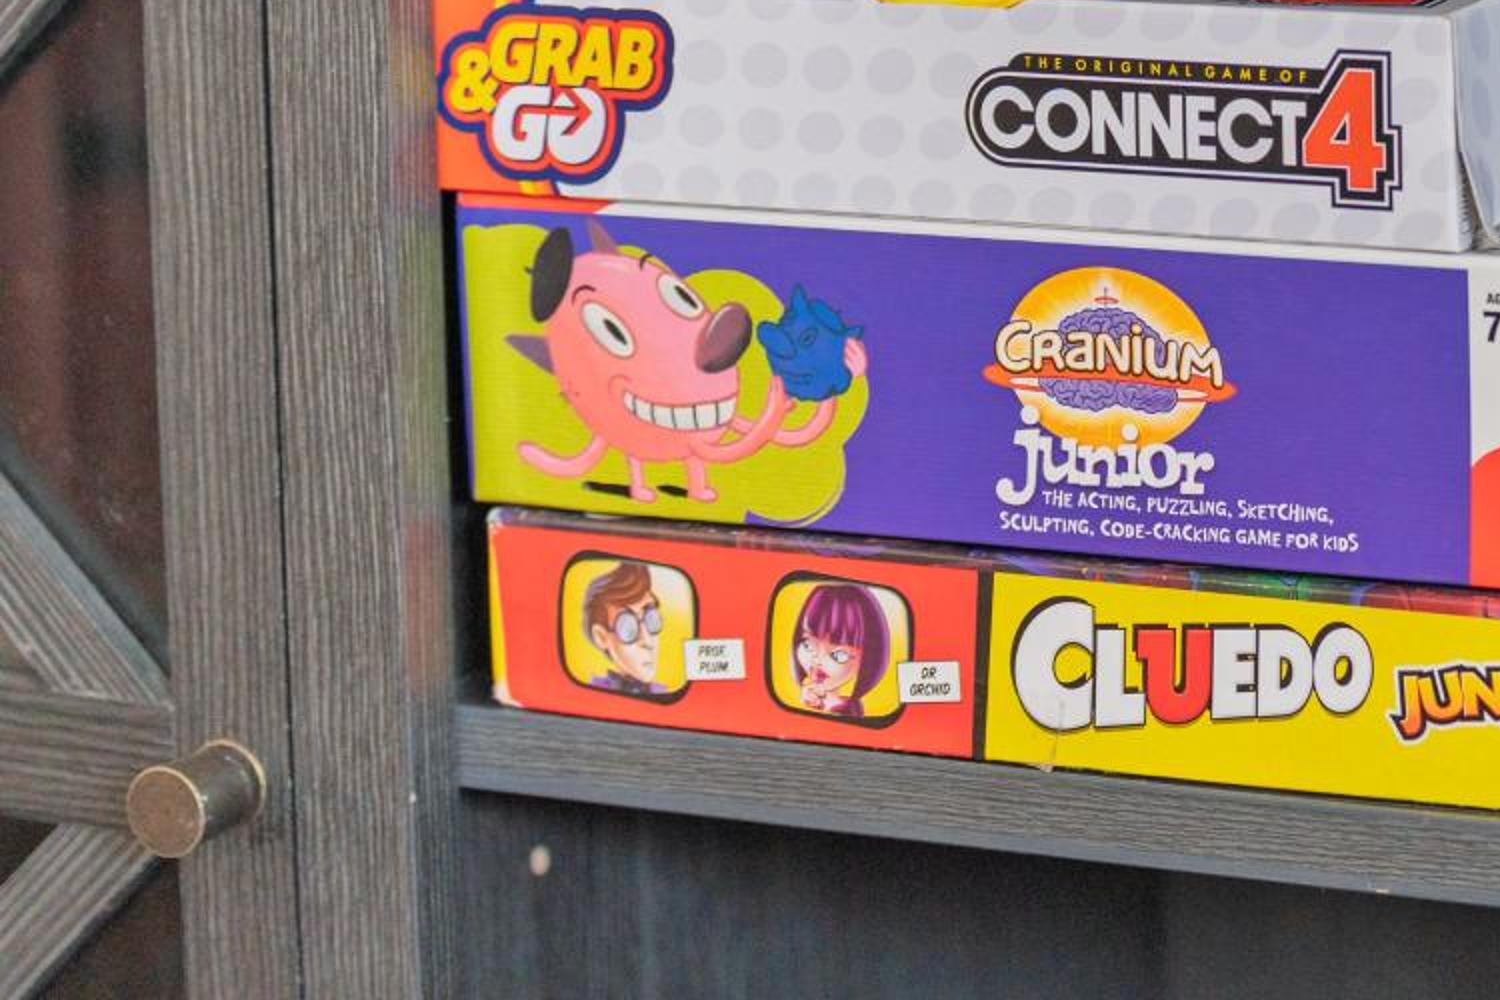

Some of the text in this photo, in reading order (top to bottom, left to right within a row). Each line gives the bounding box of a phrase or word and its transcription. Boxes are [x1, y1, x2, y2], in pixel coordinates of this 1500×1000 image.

[489, 22, 656, 90] GRAB
[1024, 56, 1309, 83] THE ORIGINAL GAME OF
[444, 48, 607, 164] & GO
[980, 67, 1386, 193] CONNECT 4
[1043, 491, 1334, 525] THE ACTING, PUZZLING, SKETCHING,
[1000, 512, 1094, 537] SCULPTING,
[1100, 519, 1231, 544] CODE-CRACKING
[1236, 530, 1281, 547] GAME
[1286, 533, 1318, 549] FOR
[921, 666, 938, 680] DR
[1010, 595, 1375, 733] CLUEDO
[909, 681, 951, 697] ORCHID
